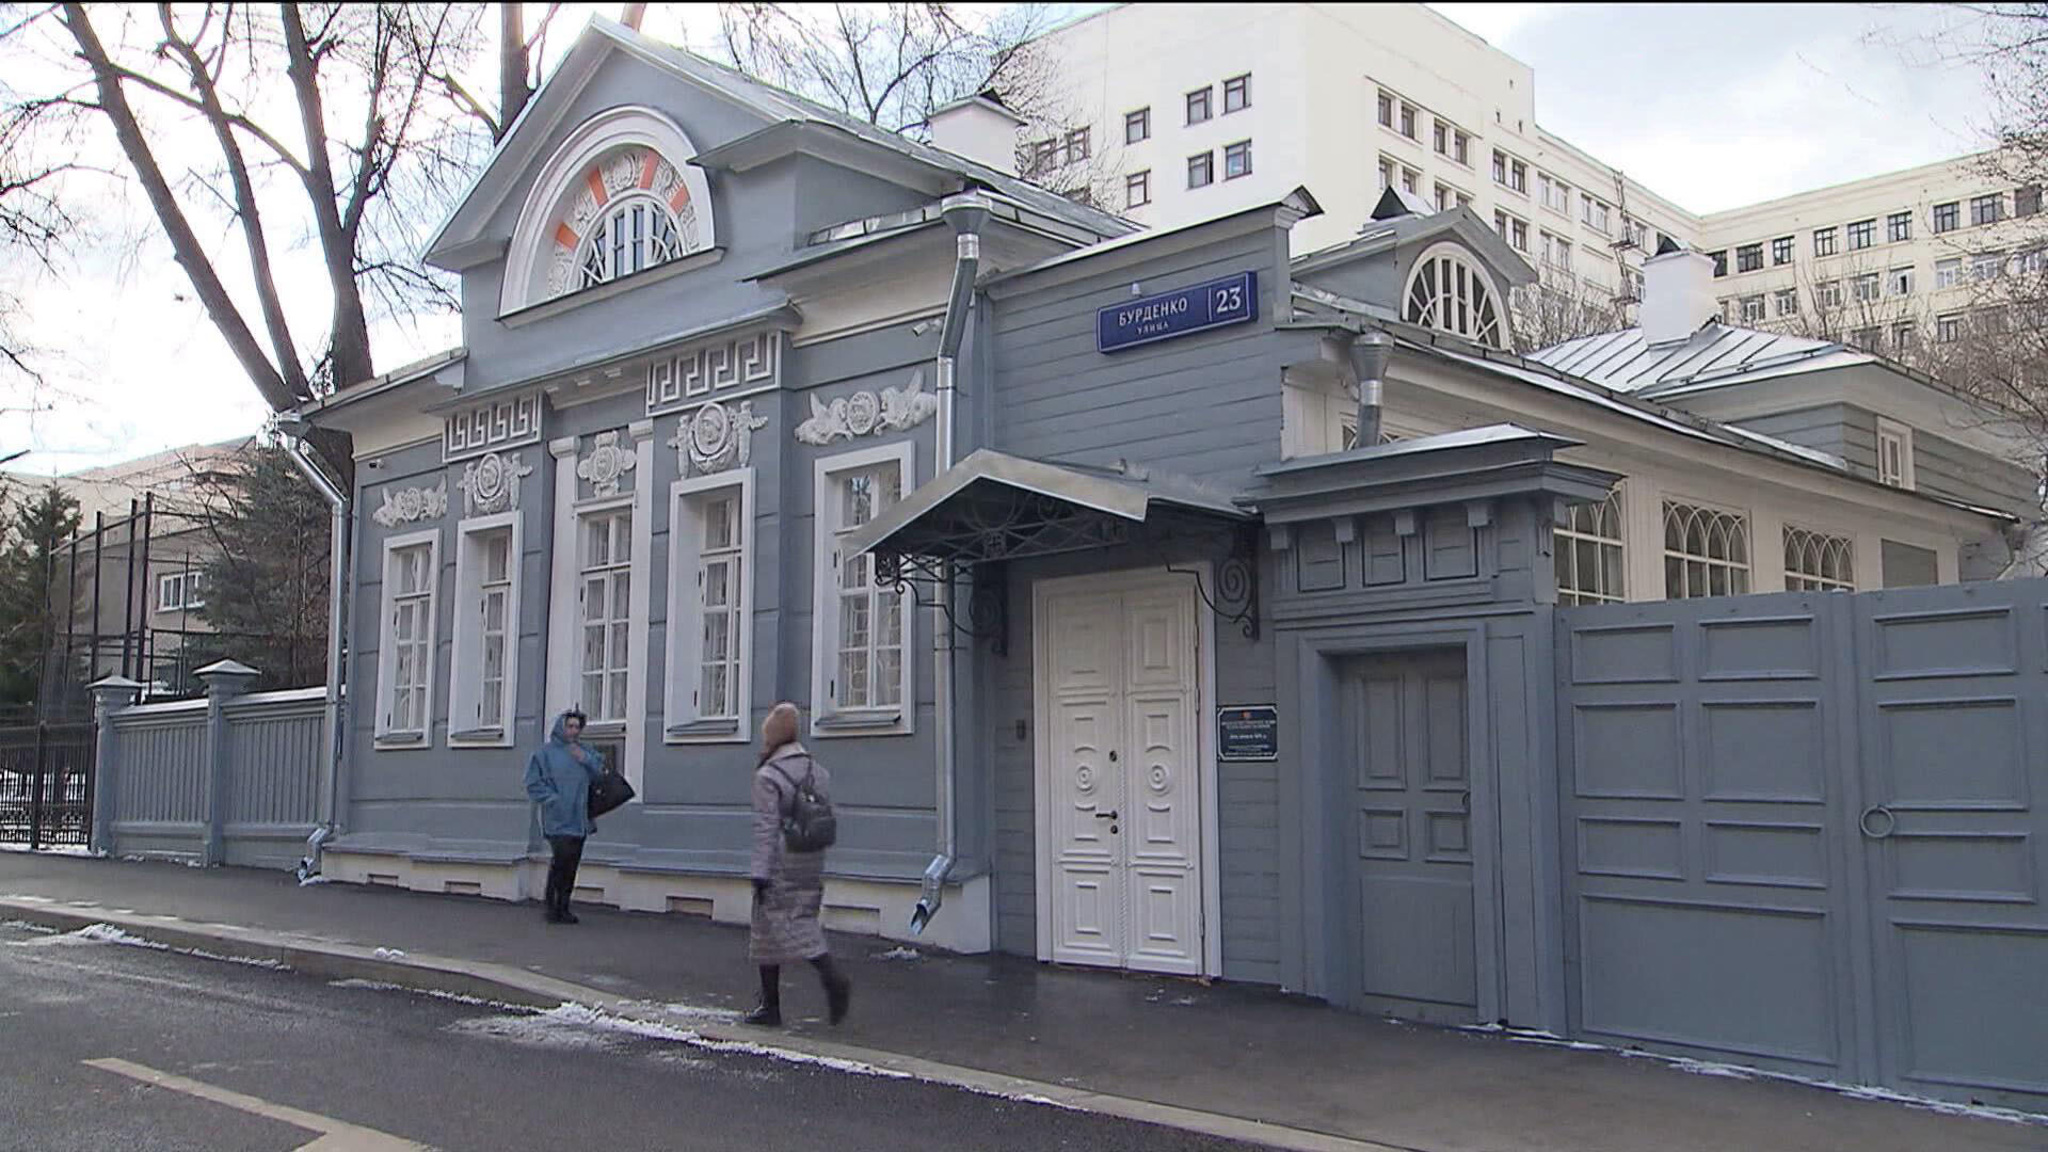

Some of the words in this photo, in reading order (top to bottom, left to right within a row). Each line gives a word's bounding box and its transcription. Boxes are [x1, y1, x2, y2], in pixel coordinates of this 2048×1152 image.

[1119, 297, 1187, 326] БУРДЕНКО
[1216, 286, 1241, 313] 23
[1137, 321, 1169, 335] УЛИЦА
